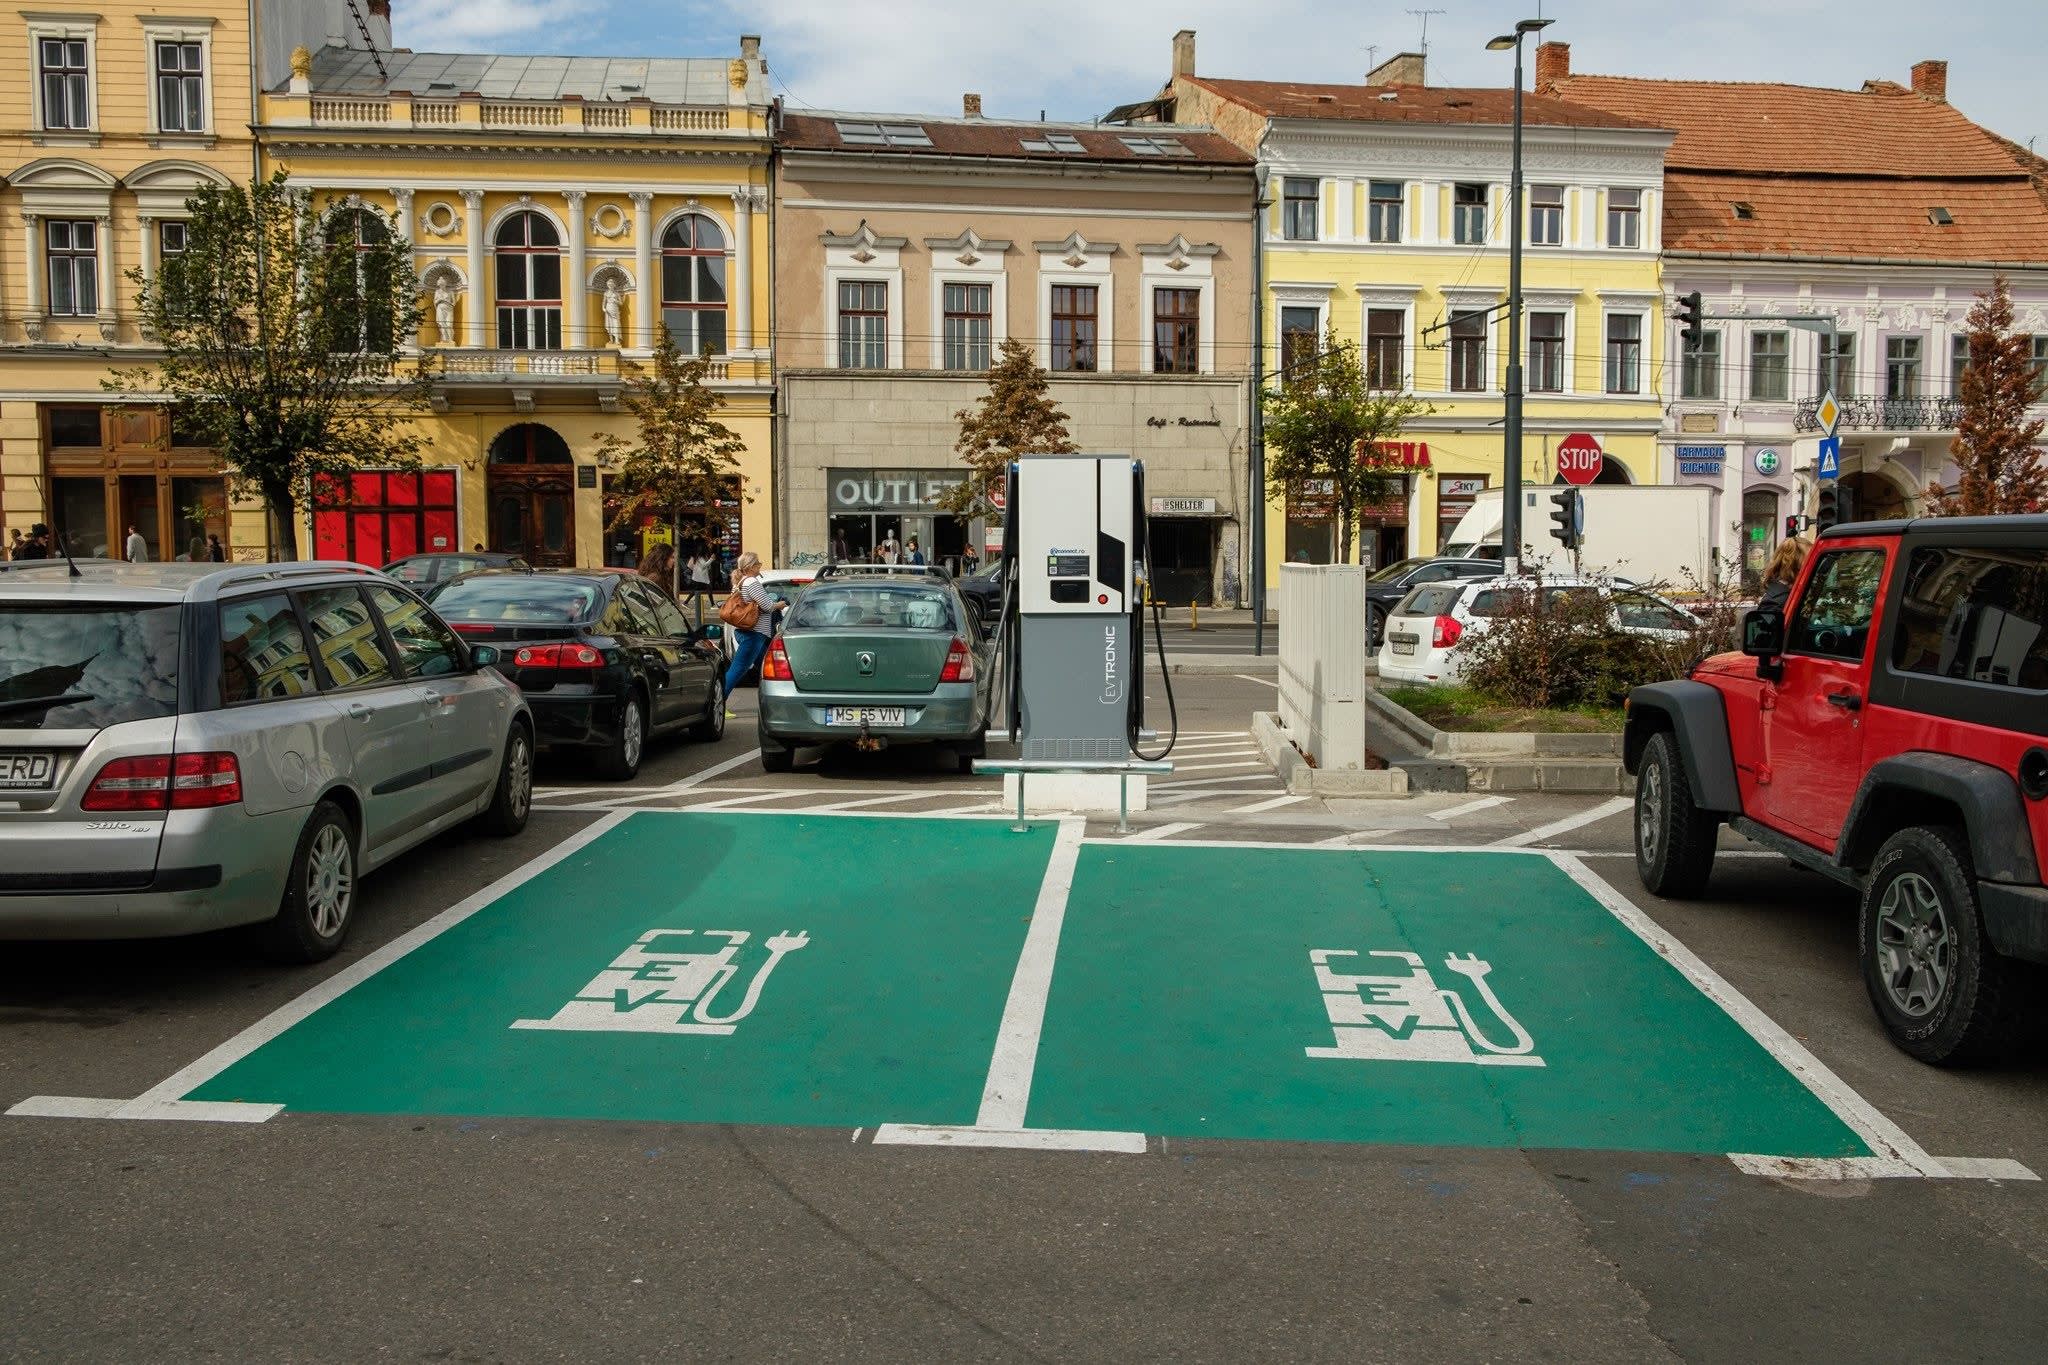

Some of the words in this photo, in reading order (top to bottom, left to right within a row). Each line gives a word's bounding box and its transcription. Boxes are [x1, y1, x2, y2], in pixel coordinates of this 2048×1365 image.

[1677, 446, 1725, 457] FARMACIA
[1560, 448, 1599, 470] STOP
[1681, 461, 1721, 473] RICHTER
[1170, 500, 1203, 510] SHELTER
[1105, 626, 1116, 697] EVTRONIC
[836, 708, 854, 721] MS
[861, 708, 876, 721] 65
[879, 708, 901, 721] VIV
[86, 821, 131, 830] Stilo
